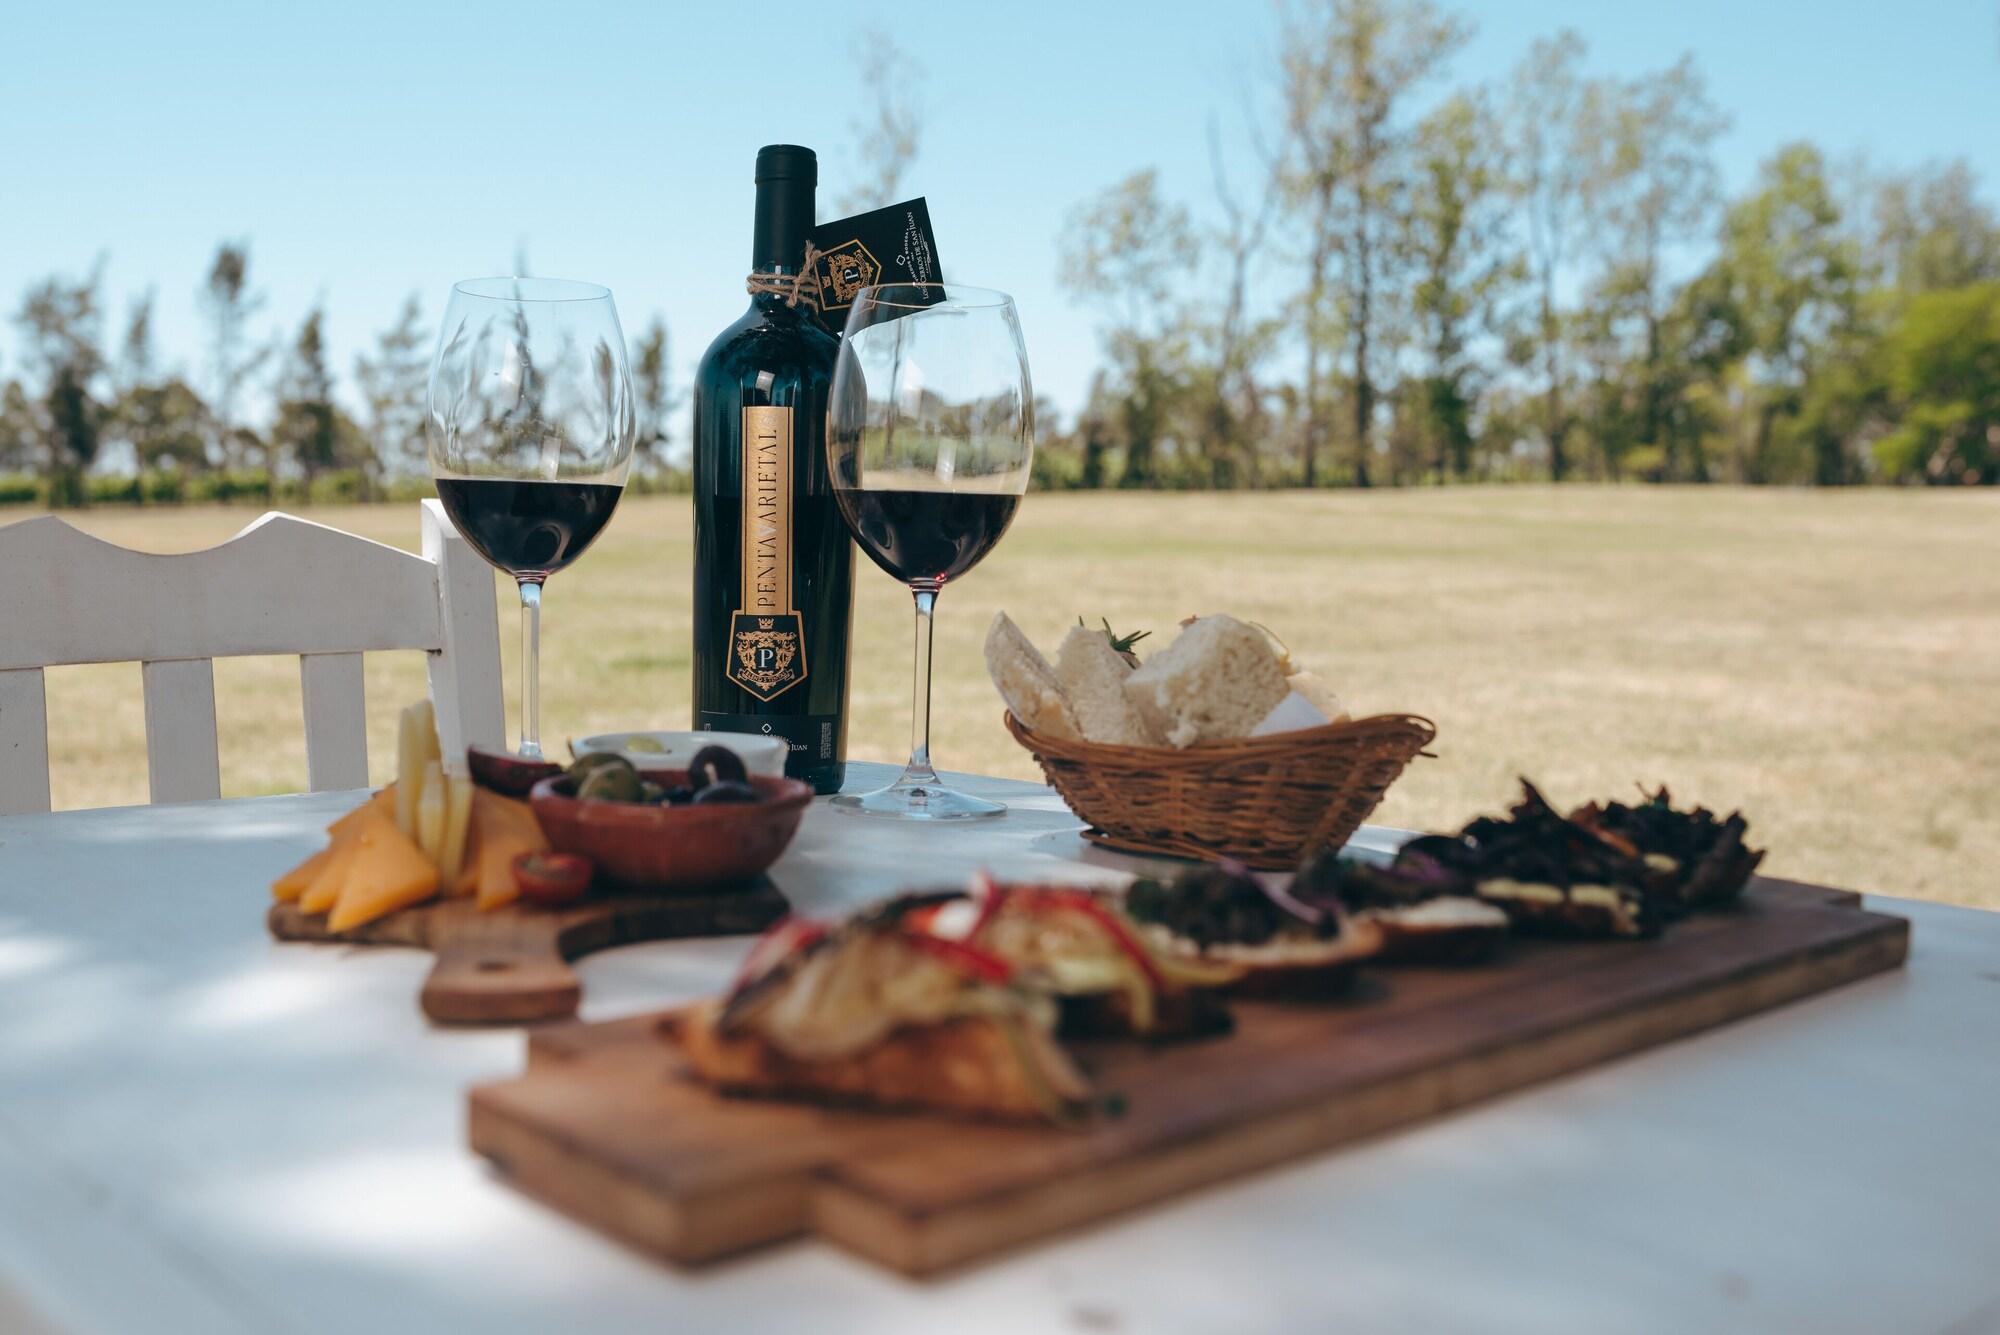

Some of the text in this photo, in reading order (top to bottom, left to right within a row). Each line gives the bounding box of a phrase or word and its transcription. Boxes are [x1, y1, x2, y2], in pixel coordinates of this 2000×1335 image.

[907, 211, 917, 230] JUAN
[911, 230, 919, 246] SAN
[844, 269, 859, 280] P
[757, 429, 777, 608] PENTAVARIETAL
[758, 648, 774, 668] P
[791, 743, 808, 752] JUAN
